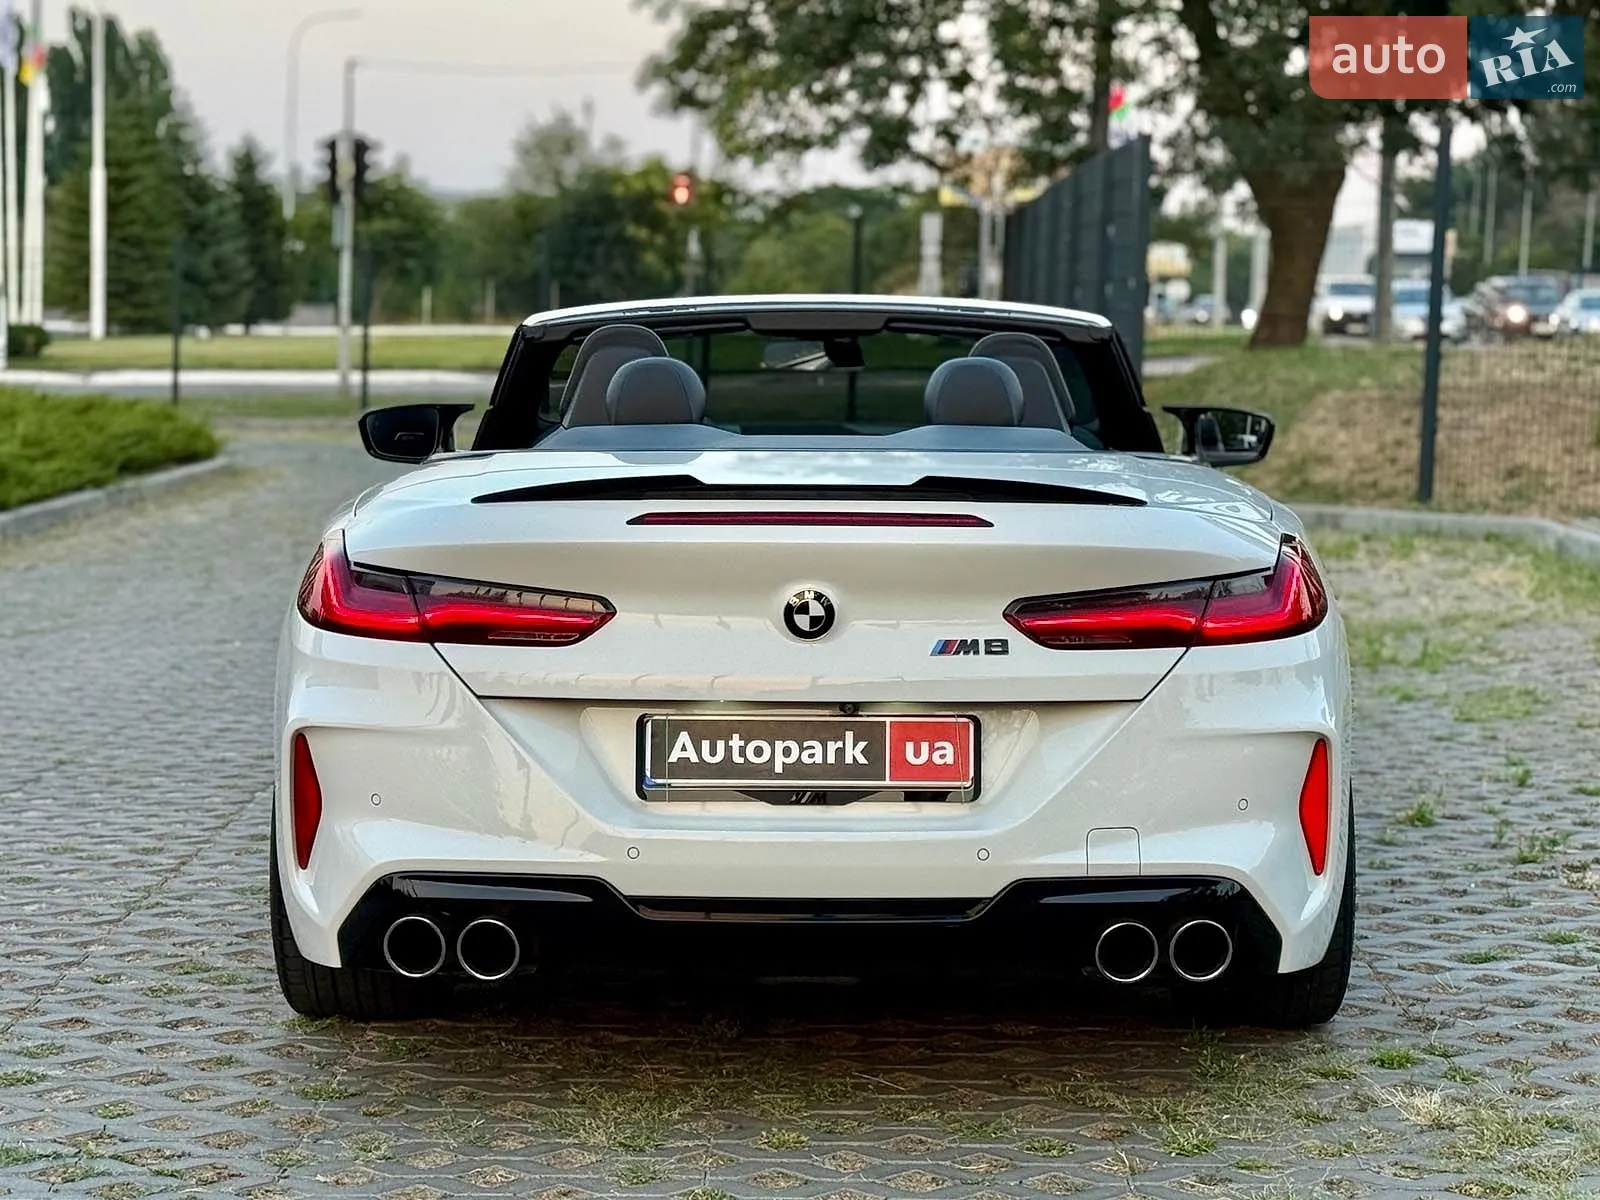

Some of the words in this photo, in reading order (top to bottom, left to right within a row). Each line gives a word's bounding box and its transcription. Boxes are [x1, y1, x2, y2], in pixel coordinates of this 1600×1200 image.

[788, 590, 832, 606] BMW
[667, 731, 869, 774] Autopark
[904, 740, 955, 766] ua
